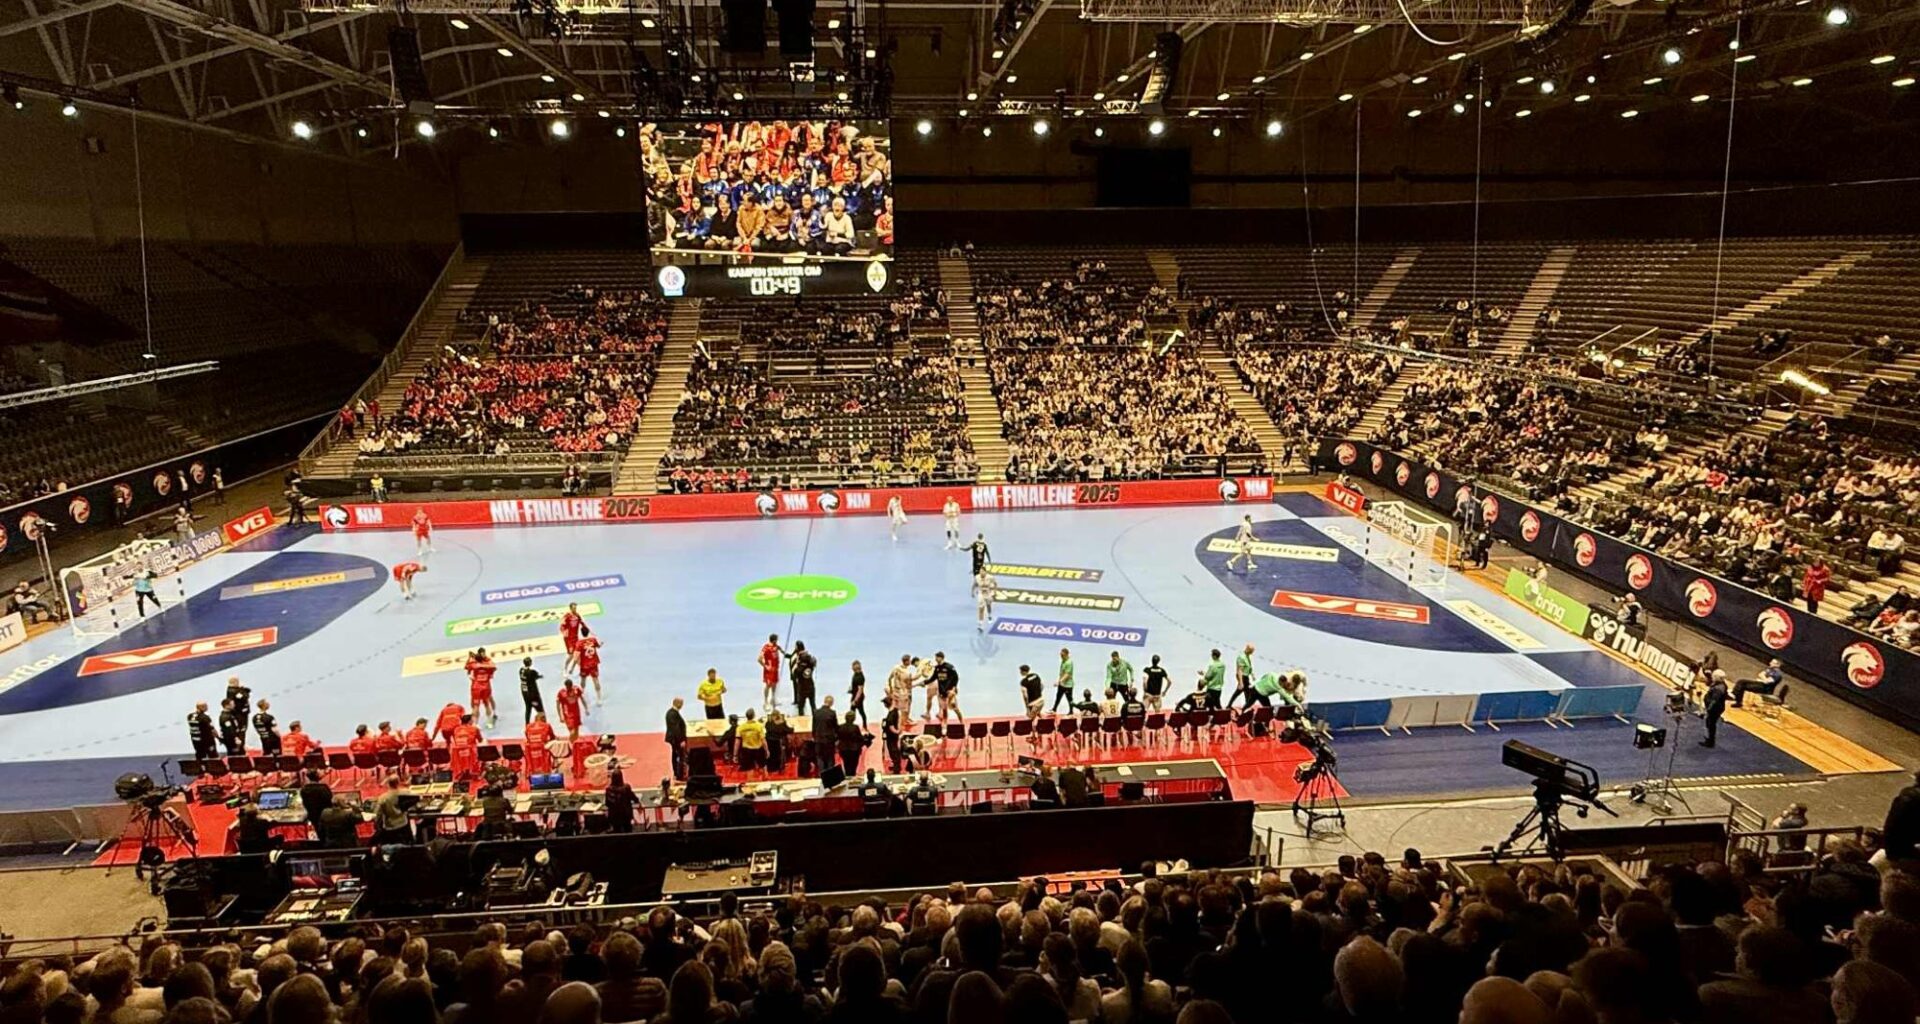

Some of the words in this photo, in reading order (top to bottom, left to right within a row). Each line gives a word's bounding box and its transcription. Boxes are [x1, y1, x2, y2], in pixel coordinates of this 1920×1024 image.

[750, 277, 801, 295] 00:49
[972, 484, 1076, 508] NM-FINALENE
[1078, 484, 1120, 504] 2025
[1244, 479, 1268, 497] NM
[1333, 486, 1358, 509] VG
[490, 498, 603, 523] NM-FINALENE
[605, 498, 650, 518] 2025
[782, 493, 809, 511] NM
[845, 492, 871, 509] NM
[232, 513, 267, 535] VG
[354, 506, 383, 524] NM
[192, 531, 222, 555] 1000
[486, 585, 560, 601] REMA
[565, 577, 620, 591] 1000
[782, 589, 848, 600] bring
[1019, 591, 1120, 609] hummel
[1288, 594, 1418, 619] VG
[1535, 593, 1566, 622] bring
[997, 621, 1074, 637] REMA
[1080, 628, 1142, 642] 1000
[101, 632, 264, 665] VG
[435, 641, 551, 667] Scndic
